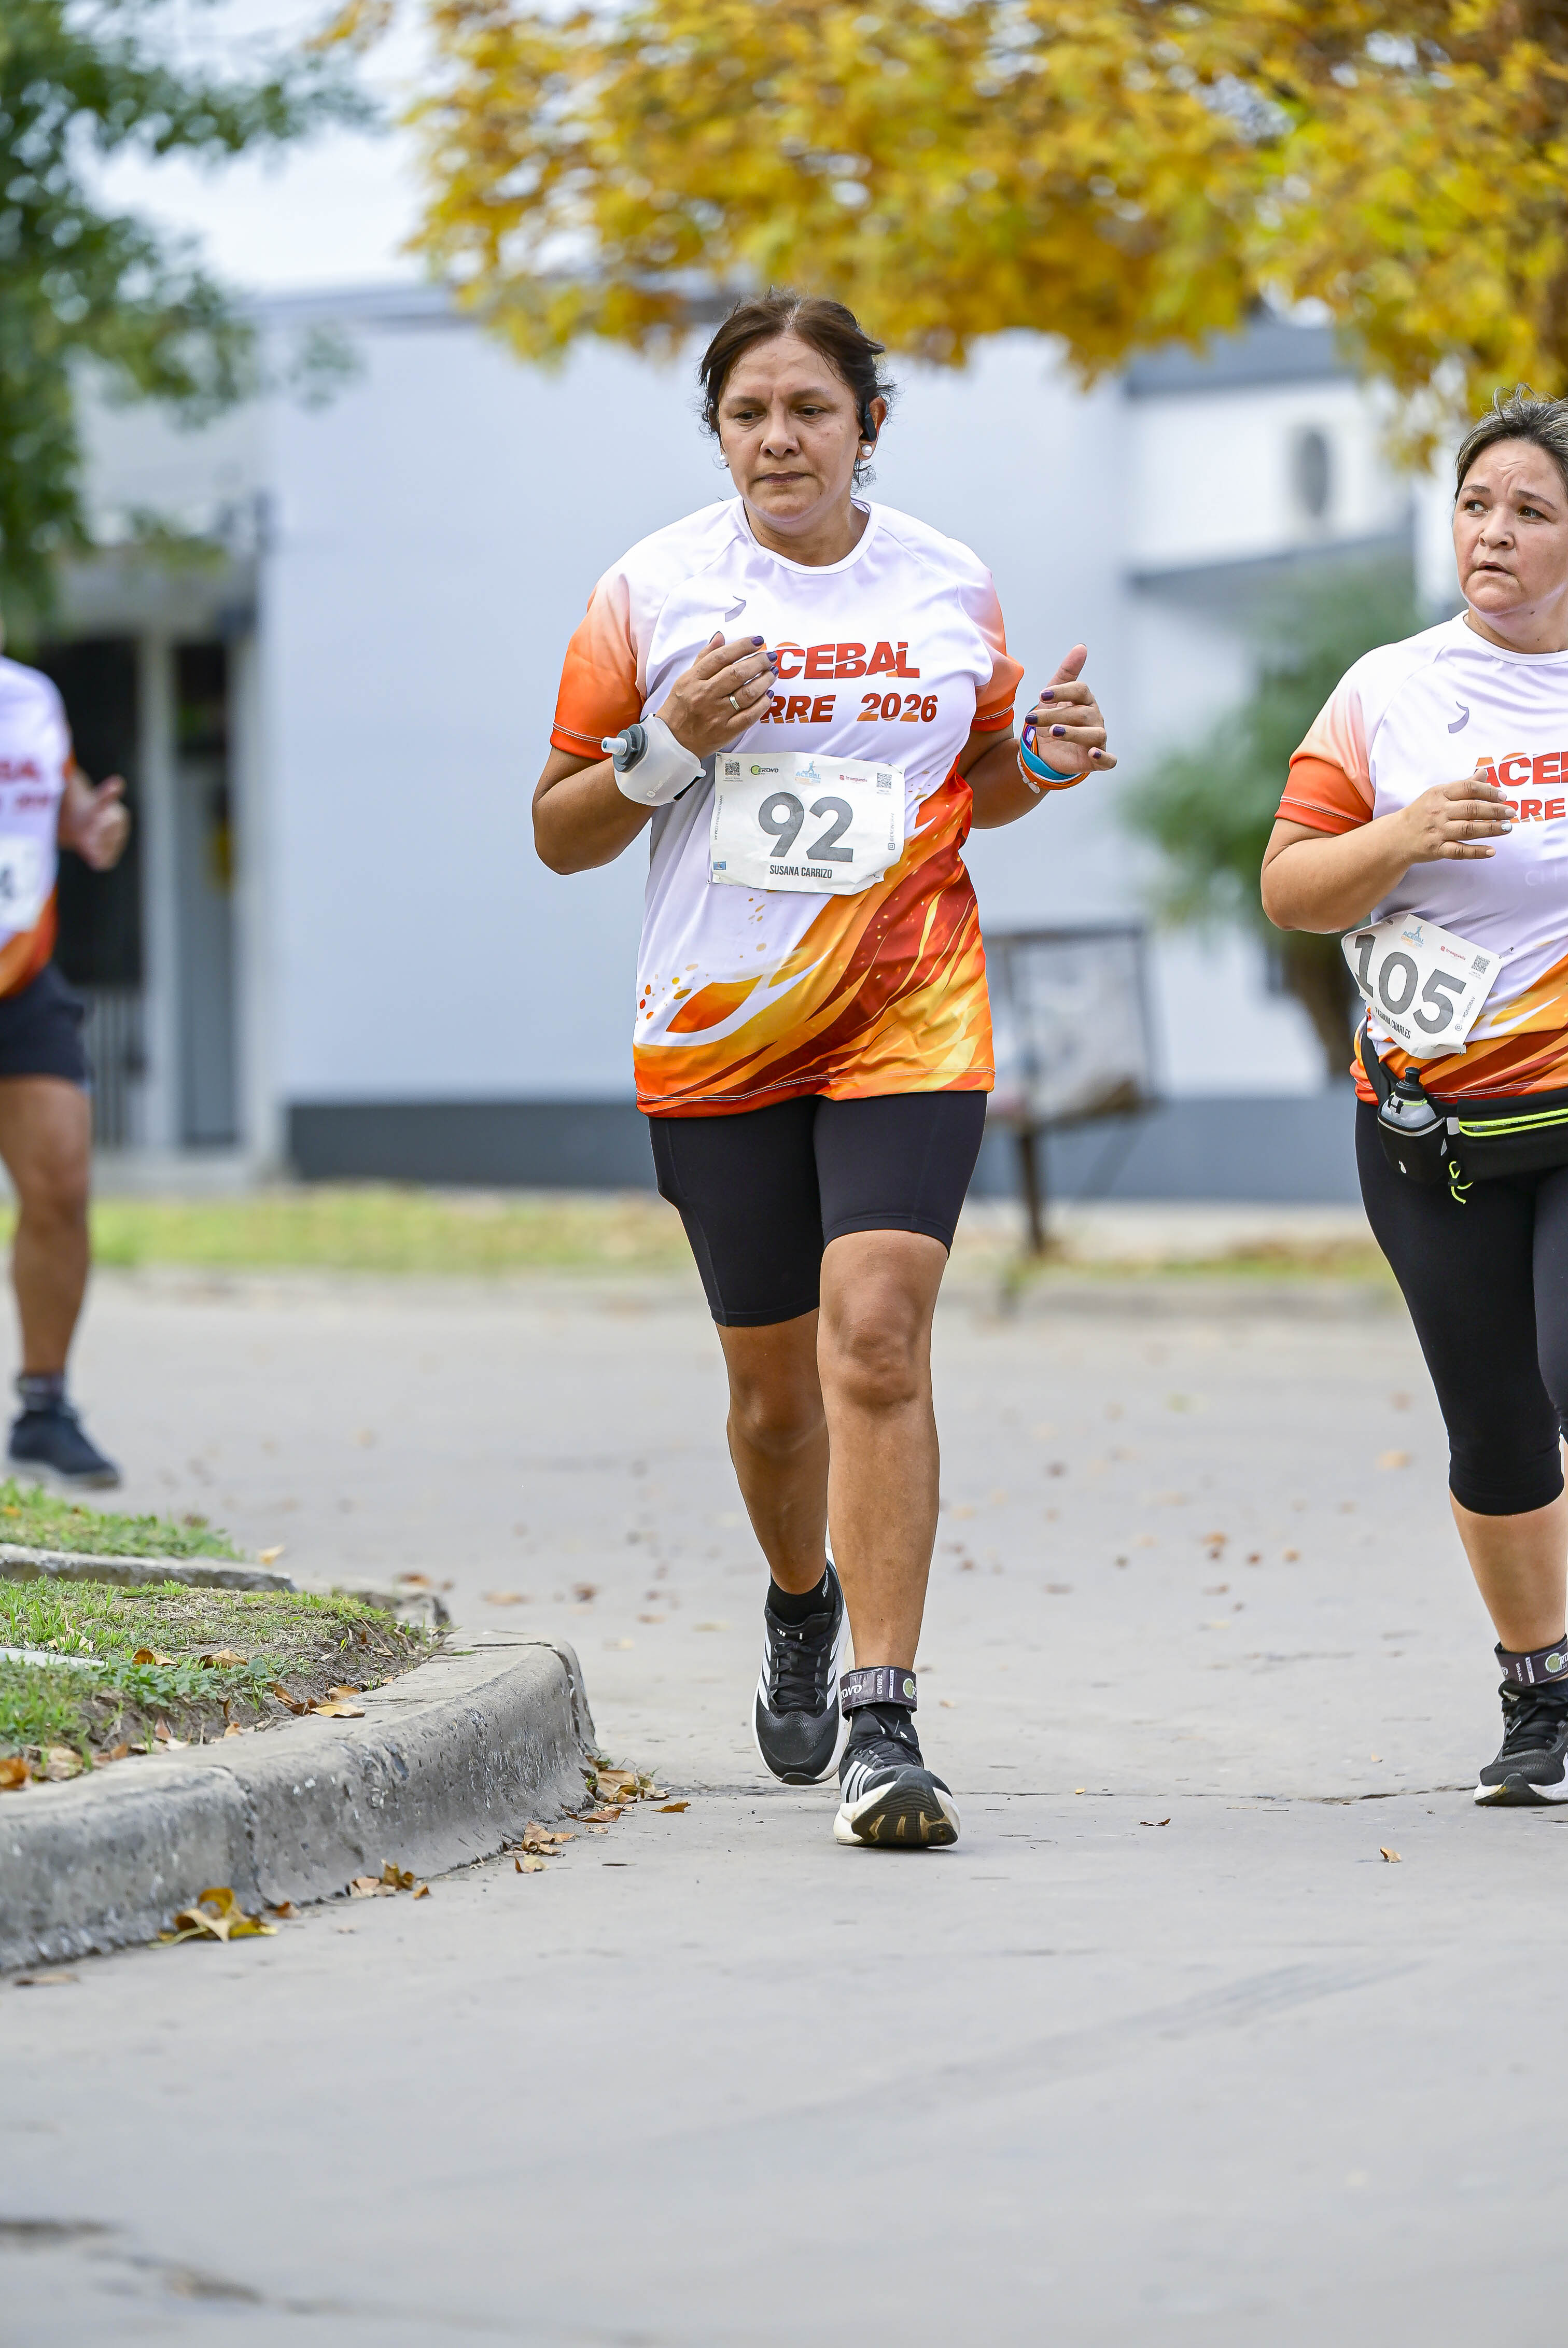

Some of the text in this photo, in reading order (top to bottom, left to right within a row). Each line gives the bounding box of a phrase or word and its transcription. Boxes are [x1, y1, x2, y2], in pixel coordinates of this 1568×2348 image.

[758, 641, 920, 679] CEBAL
[760, 693, 938, 724] RRE 2026
[1474, 751, 1568, 787] ACE
[758, 792, 854, 863] 92
[769, 864, 833, 879] SUSANA CARRIZO
[1354, 933, 1467, 1033] 105
[1391, 1019, 1411, 1039] CHARLES
